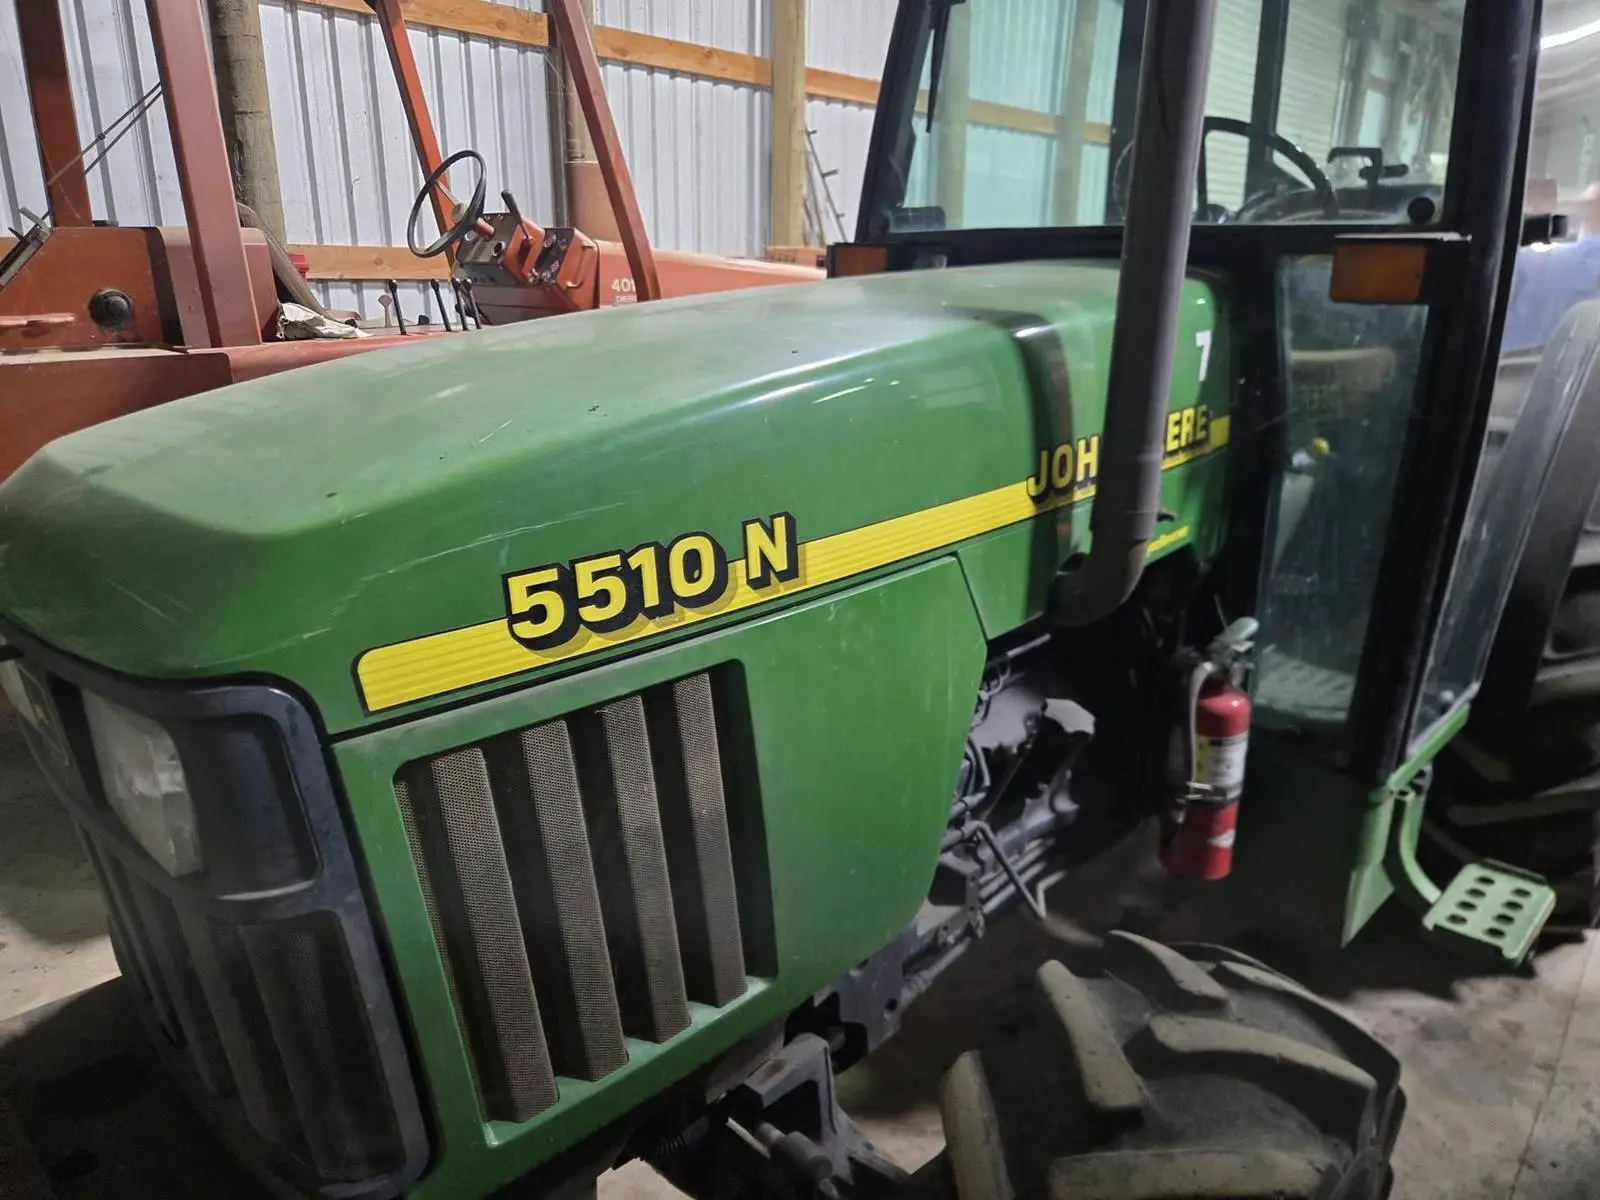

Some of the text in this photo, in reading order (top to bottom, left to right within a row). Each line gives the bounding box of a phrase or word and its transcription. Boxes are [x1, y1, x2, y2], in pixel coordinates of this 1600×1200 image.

[1196, 330, 1212, 381] 7
[1026, 403, 1211, 501] JOH ERE
[501, 511, 798, 651] 5510 N
